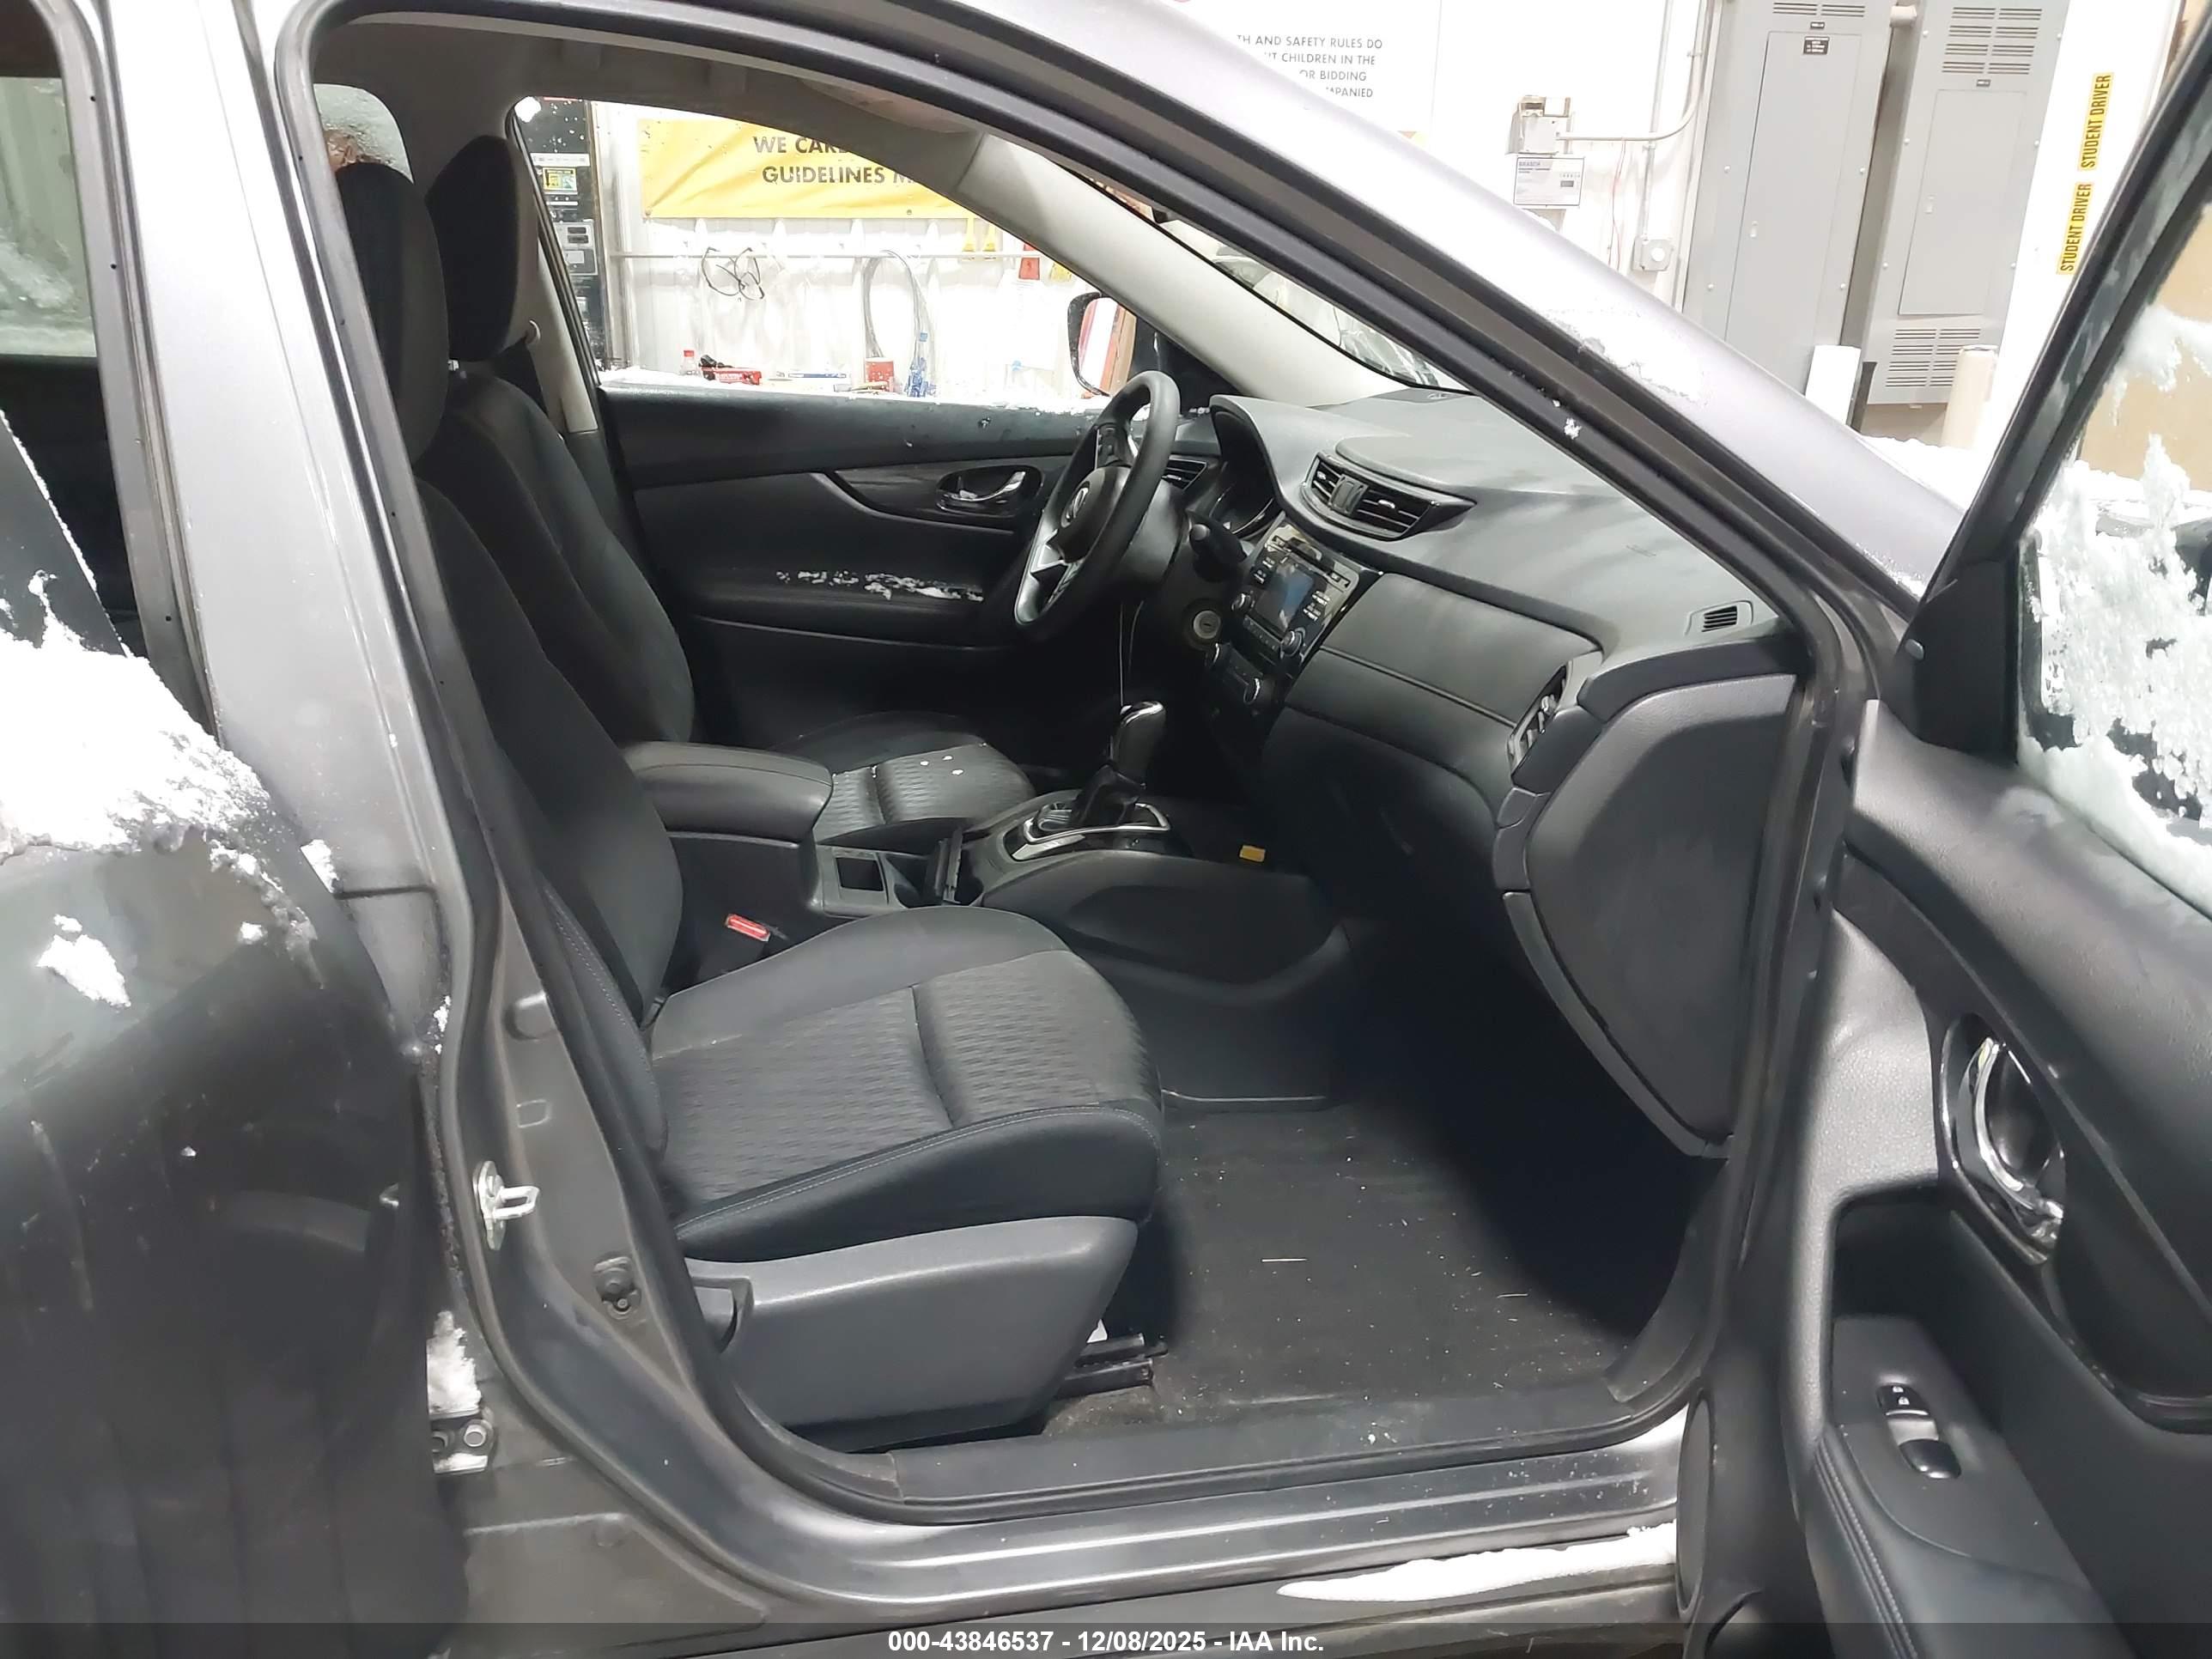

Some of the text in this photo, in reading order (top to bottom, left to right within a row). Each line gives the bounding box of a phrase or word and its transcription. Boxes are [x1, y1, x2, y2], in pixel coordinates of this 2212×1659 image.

[1255, 36, 1281, 46] AND
[1286, 36, 1325, 46] SAFETY
[1331, 38, 1362, 48] RULES
[1367, 40, 1382, 49] DO
[1282, 53, 1336, 64] CHILDREN
[1341, 55, 1352, 64] IN
[1358, 55, 1374, 65] THE
[1321, 70, 1366, 81] BIDDING
[2081, 75, 2112, 168] STUDENT DRIVER
[752, 137, 787, 153] WE
[762, 166, 885, 184] GUIDELINES
[2060, 183, 2092, 271] STUDENT DRIVER
